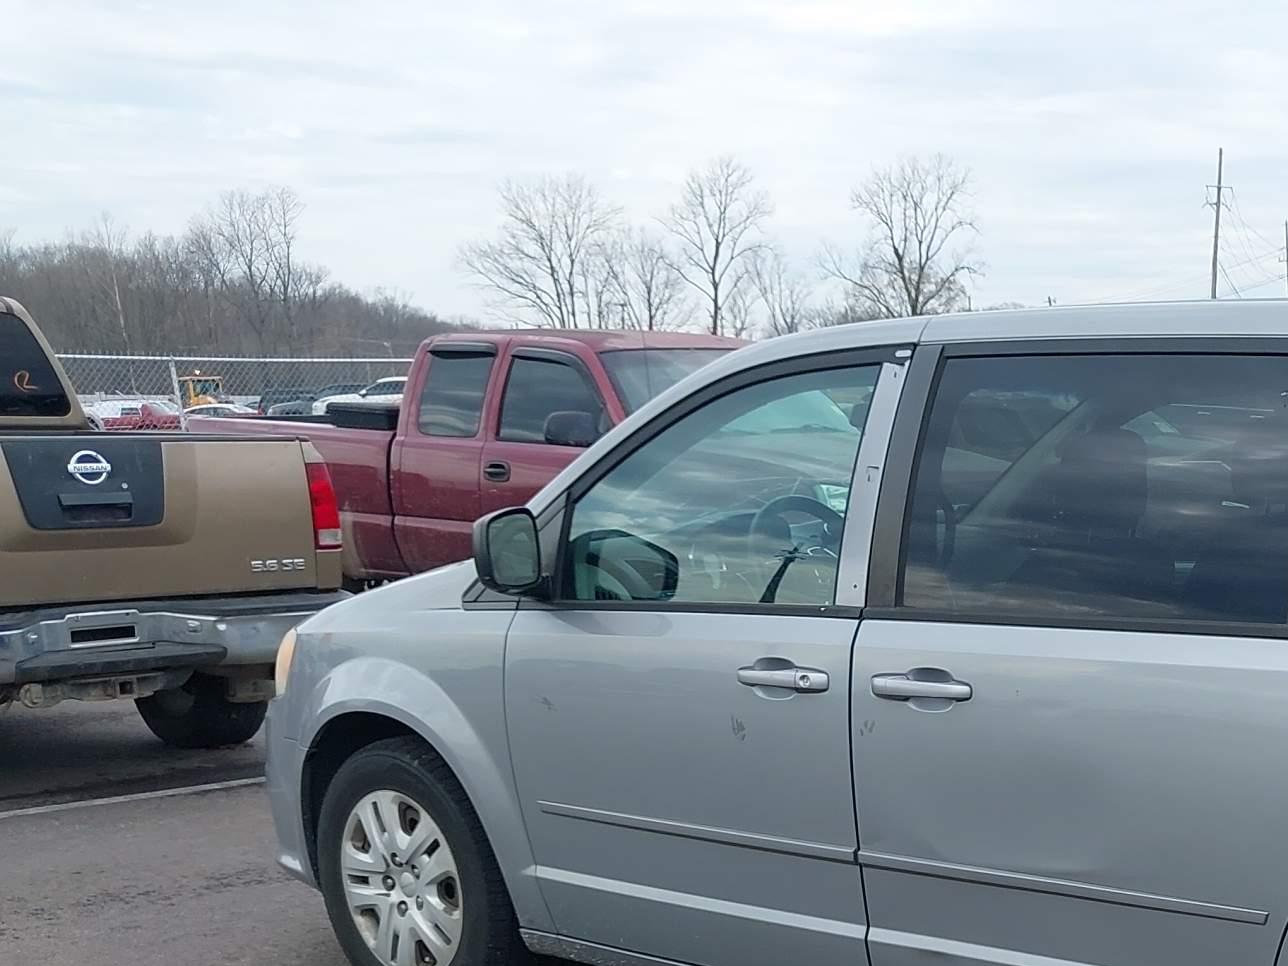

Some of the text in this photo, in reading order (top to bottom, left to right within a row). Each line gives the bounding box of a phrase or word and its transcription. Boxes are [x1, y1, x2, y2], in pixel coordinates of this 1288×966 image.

[73, 464, 108, 472] NISSAN
[250, 558, 305, 573] 5.6 SE
